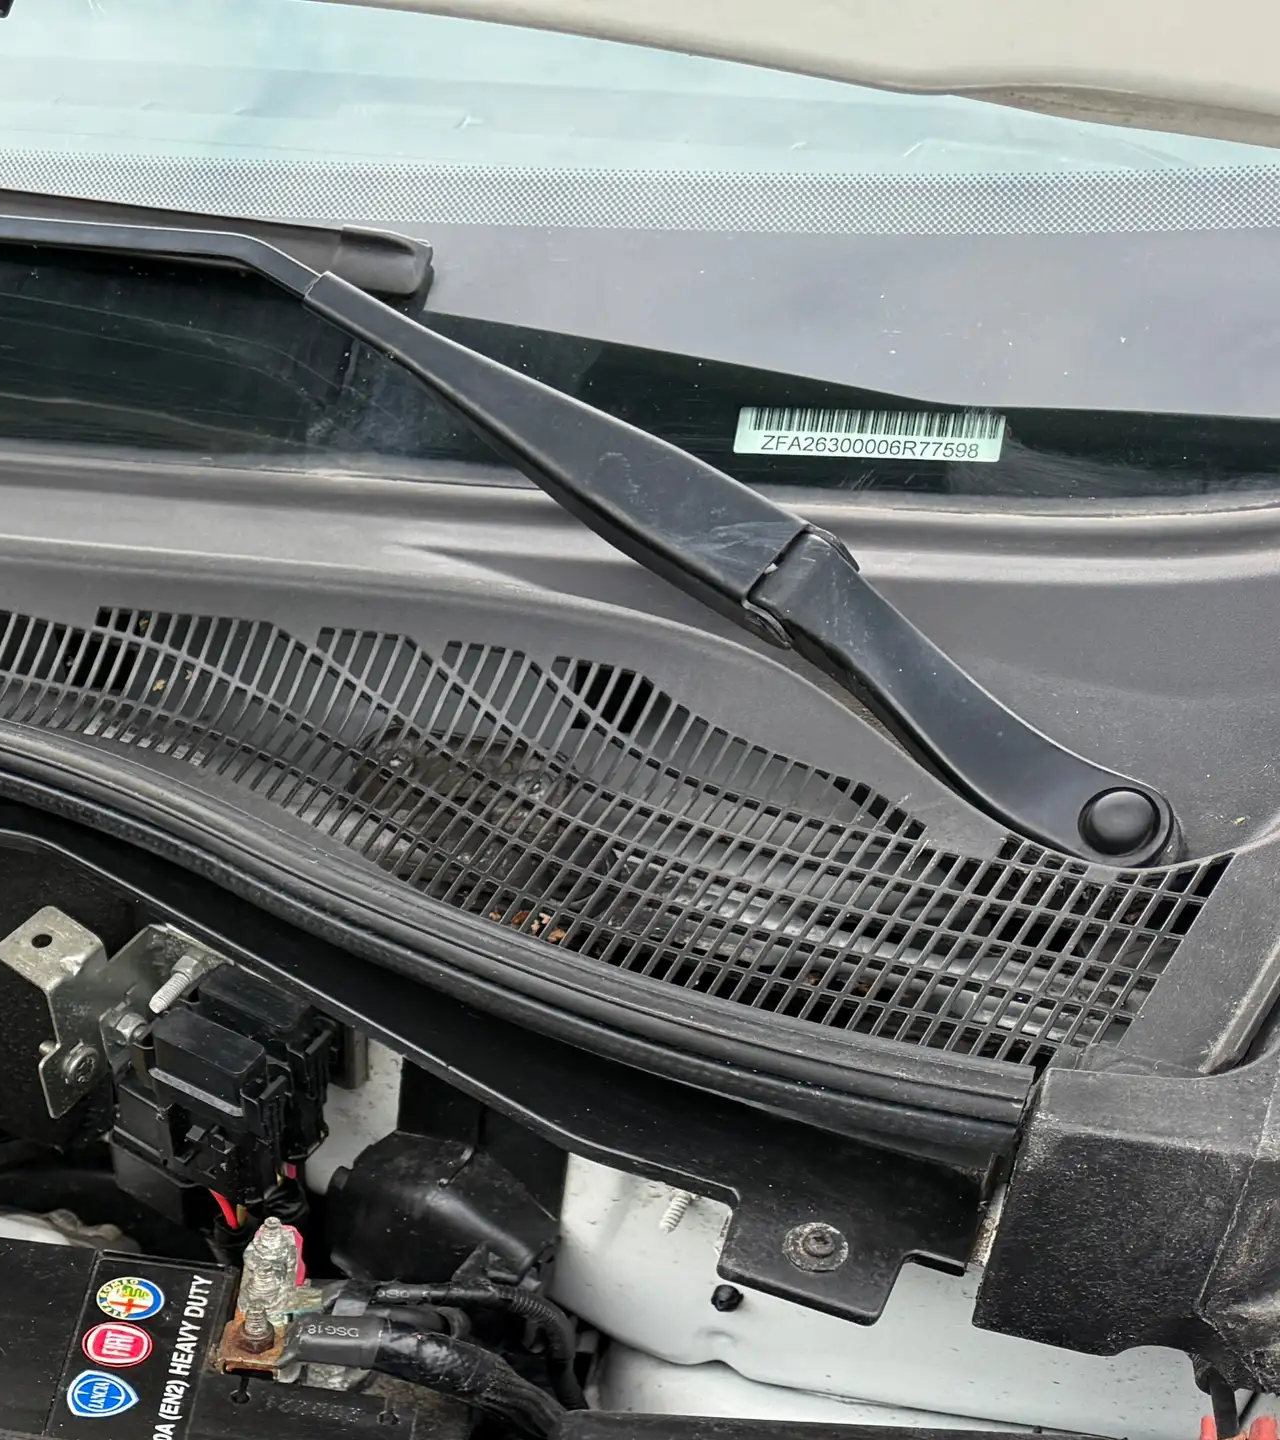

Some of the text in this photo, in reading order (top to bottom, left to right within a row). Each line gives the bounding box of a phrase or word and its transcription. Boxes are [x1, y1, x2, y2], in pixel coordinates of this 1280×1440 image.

[760, 432, 979, 461] ZFA26300006R77598
[183, 1273, 213, 1319] DUTY
[101, 1331, 136, 1357] FIAT
[168, 1319, 201, 1377] HEAVY
[157, 1377, 190, 1422] (EN2)
